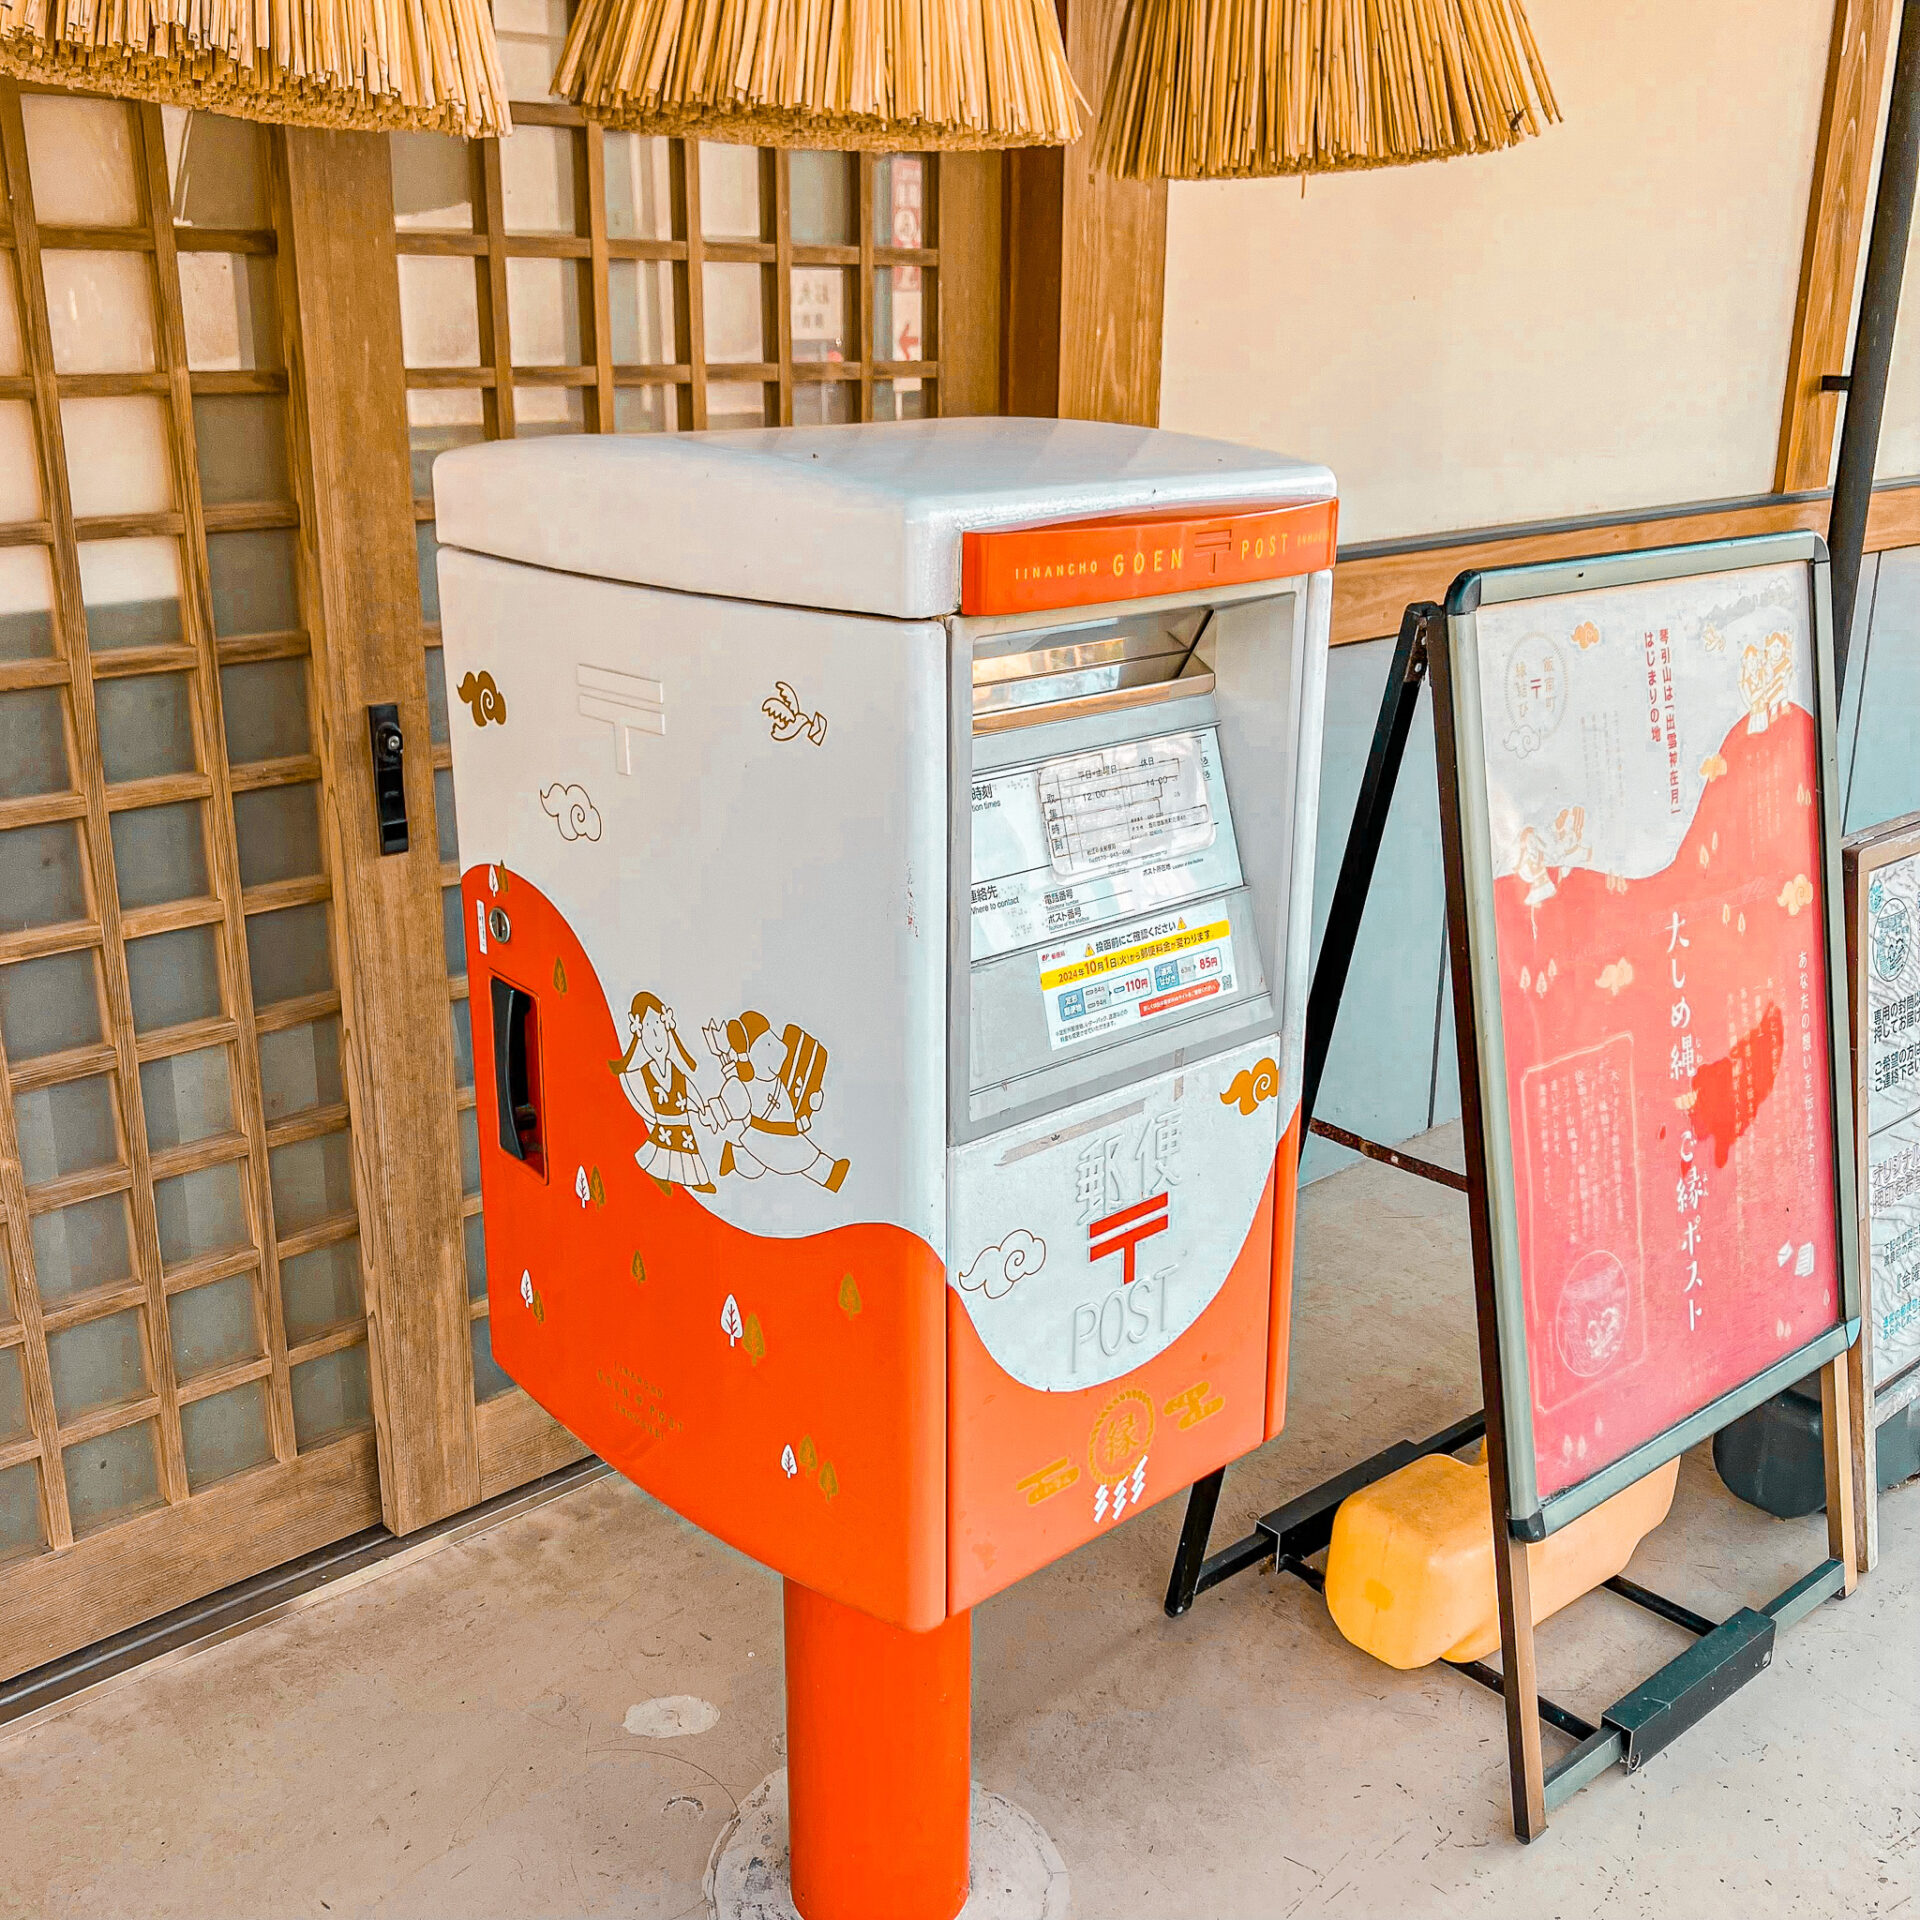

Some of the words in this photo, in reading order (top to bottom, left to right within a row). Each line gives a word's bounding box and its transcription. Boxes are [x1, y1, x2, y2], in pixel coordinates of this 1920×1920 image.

[1015, 560, 1098, 580] IINANCHO
[1112, 546, 1185, 577] GOEN
[1240, 532, 1288, 561] POST
[1644, 631, 1661, 743] はじまりの地
[1140, 756, 1155, 767] 休日
[985, 800, 1001, 811] times
[990, 899, 997, 909] to
[998, 895, 1019, 908] contact
[1044, 888, 1073, 905] 電話番号
[1048, 907, 1082, 924] ポスト番号
[1095, 920, 1177, 954] 投函前にご確認ください
[1199, 957, 1218, 970] 85円
[1125, 977, 1149, 993] 110円
[1074, 1109, 1184, 1227] 郵便
[1071, 1262, 1179, 1375] POST
[1103, 1412, 1141, 1465] 縁
